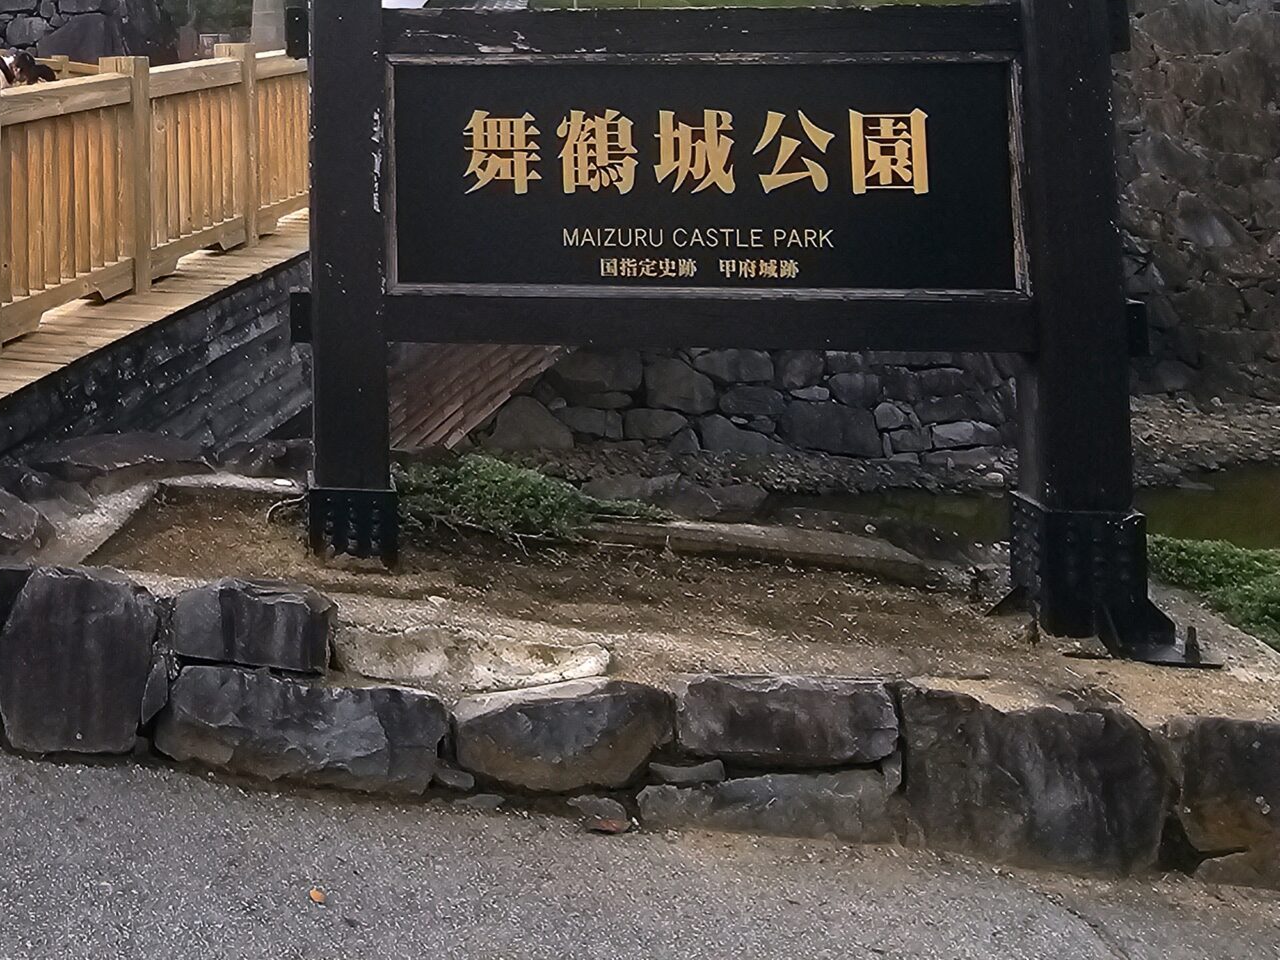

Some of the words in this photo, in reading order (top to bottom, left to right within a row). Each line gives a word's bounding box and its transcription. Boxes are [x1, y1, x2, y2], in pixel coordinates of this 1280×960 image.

[462, 107, 930, 195] 舞鶴城公園
[562, 227, 663, 247] MAIZURU
[672, 228, 764, 248] CASTLE
[773, 229, 834, 248] PARK
[600, 257, 698, 278] 国指定史跡
[718, 258, 800, 279] 甲府城跡
